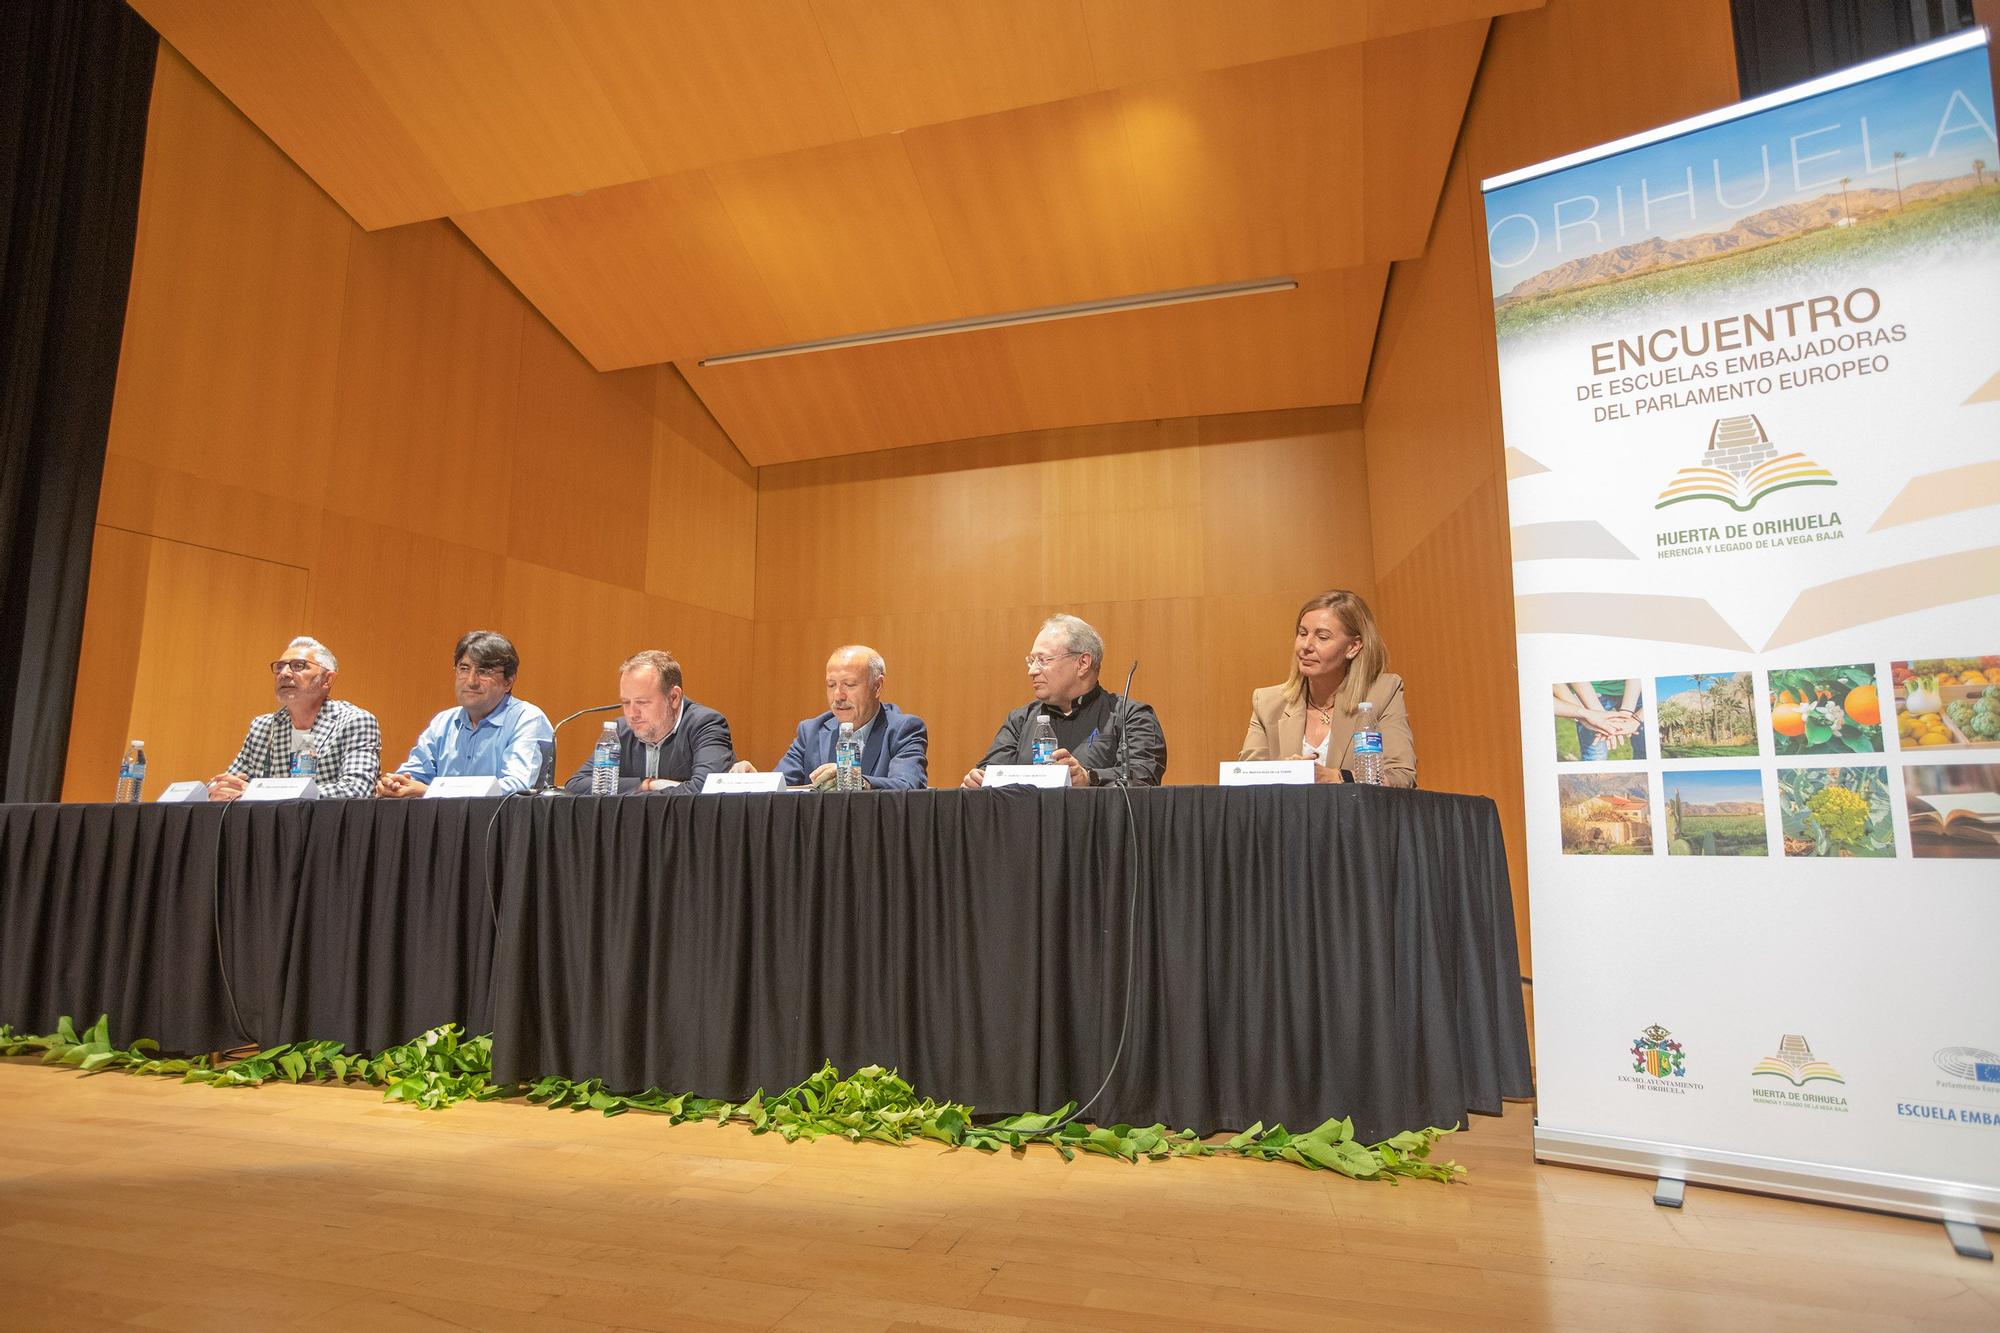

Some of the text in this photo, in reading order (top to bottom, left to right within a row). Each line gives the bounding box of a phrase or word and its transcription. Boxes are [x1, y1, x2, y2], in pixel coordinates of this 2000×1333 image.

[1489, 89, 1998, 268] ORIHUELA
[1591, 287, 1880, 375] ENCUENTRO
[1576, 324, 1907, 401] DE ESCUELAS EMBAJADORAS
[1594, 355, 1889, 423] DEL PARLAMENTO EUROPEO
[1656, 511, 1842, 547] HUERTA DE ORIHUELA
[1657, 530, 1844, 559] HERENCIA Y LEGADO DE LA VEGA BAJA
[1647, 1079, 1704, 1091] AYUNTAMIENTO
[1647, 1085, 1686, 1095] ORIHUELA
[1752, 1088, 1848, 1106] HUERTA DE ORIHUELA
[1936, 1080, 1981, 1091] Parlamento
[1897, 1103, 1957, 1121] ESCUELA
